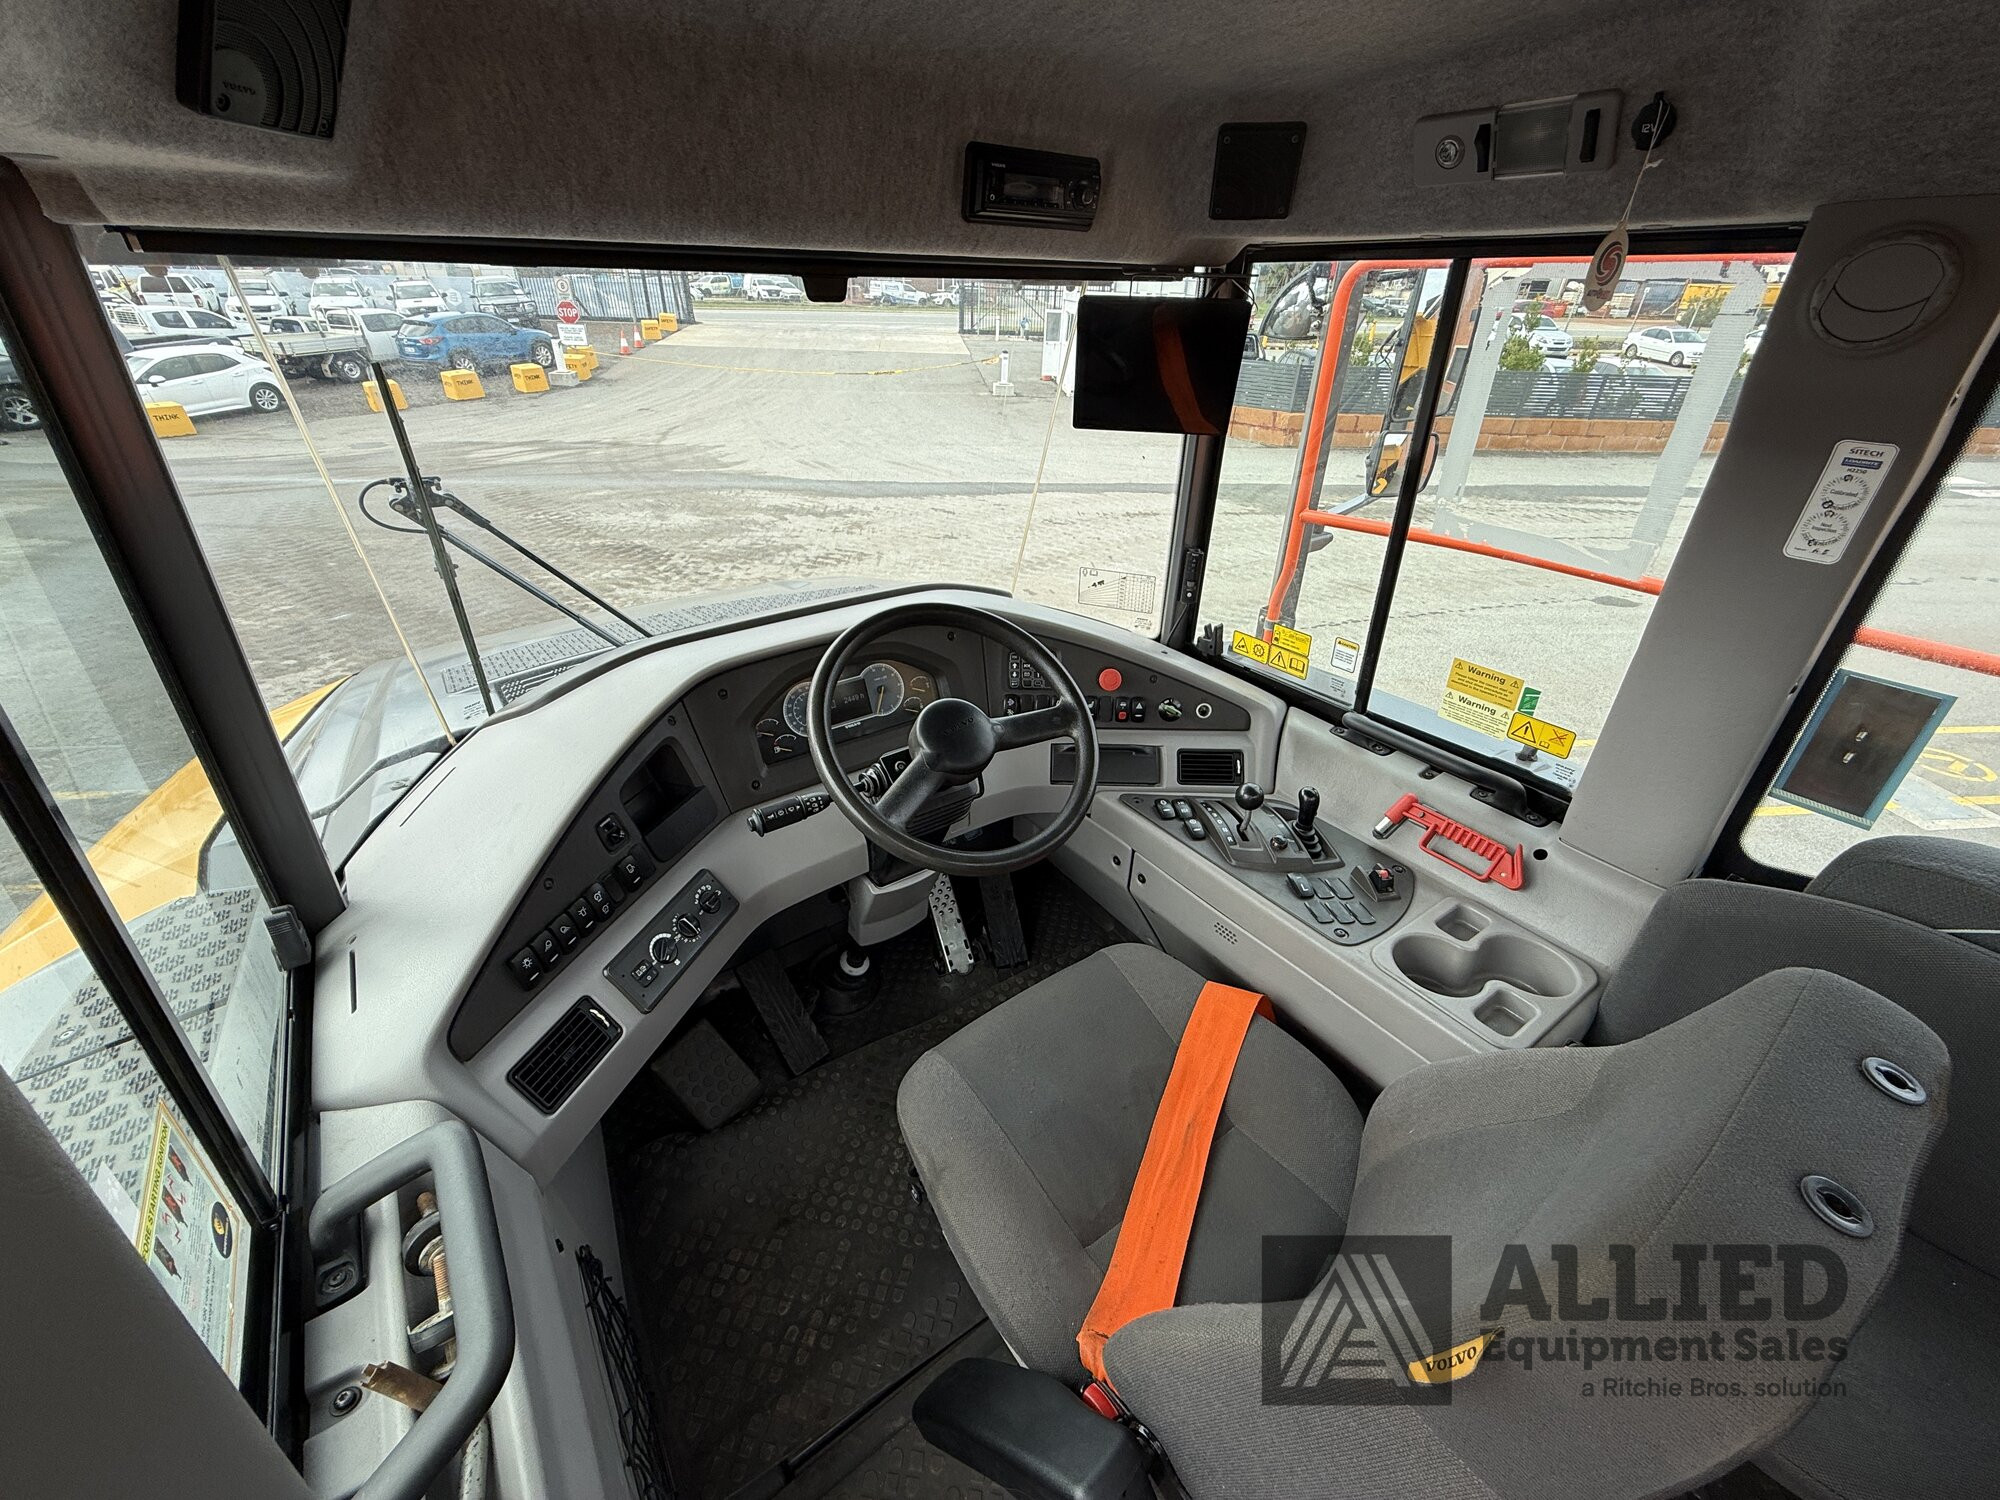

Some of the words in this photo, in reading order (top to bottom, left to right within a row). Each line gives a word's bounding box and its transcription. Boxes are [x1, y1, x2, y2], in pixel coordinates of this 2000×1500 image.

[558, 307, 578, 317] STOP
[456, 379, 474, 387] THINK
[524, 374, 541, 382] THINK
[152, 414, 180, 422] THINK
[1849, 447, 1885, 458] SITECH
[1830, 488, 1858, 498] Calibrated
[1468, 665, 1506, 686] Warning
[1458, 694, 1496, 716] Warning
[148, 1168, 160, 1225] STARTING
[156, 1122, 168, 1168] IGNITION
[1426, 1346, 1477, 1372] VOLVO
